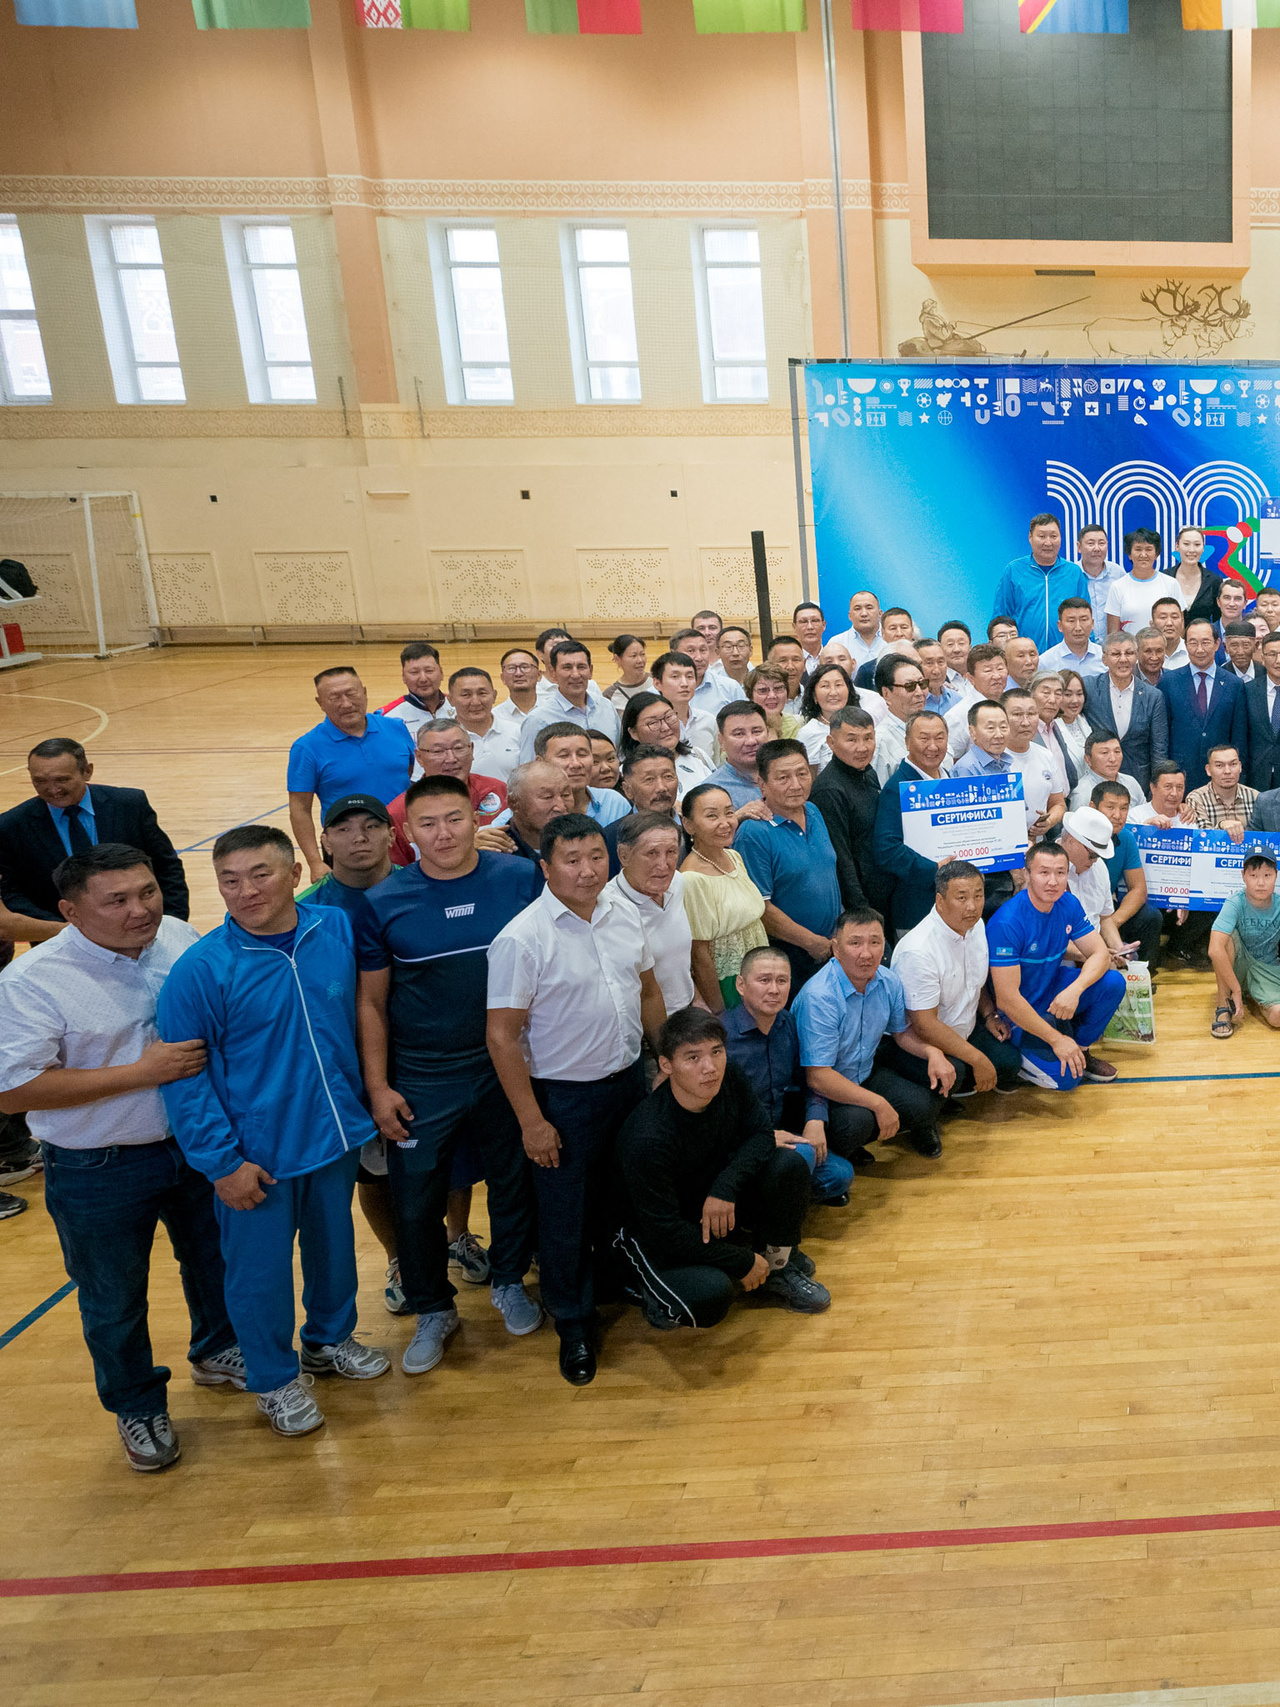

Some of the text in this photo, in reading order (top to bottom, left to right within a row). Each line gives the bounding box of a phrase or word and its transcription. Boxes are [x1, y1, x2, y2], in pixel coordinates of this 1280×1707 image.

[937, 809, 997, 824] СЕРТИФИКАТ
[959, 849, 973, 857] 000
[976, 847, 989, 856] 000
[1151, 855, 1191, 866] СЕРТИФИ
